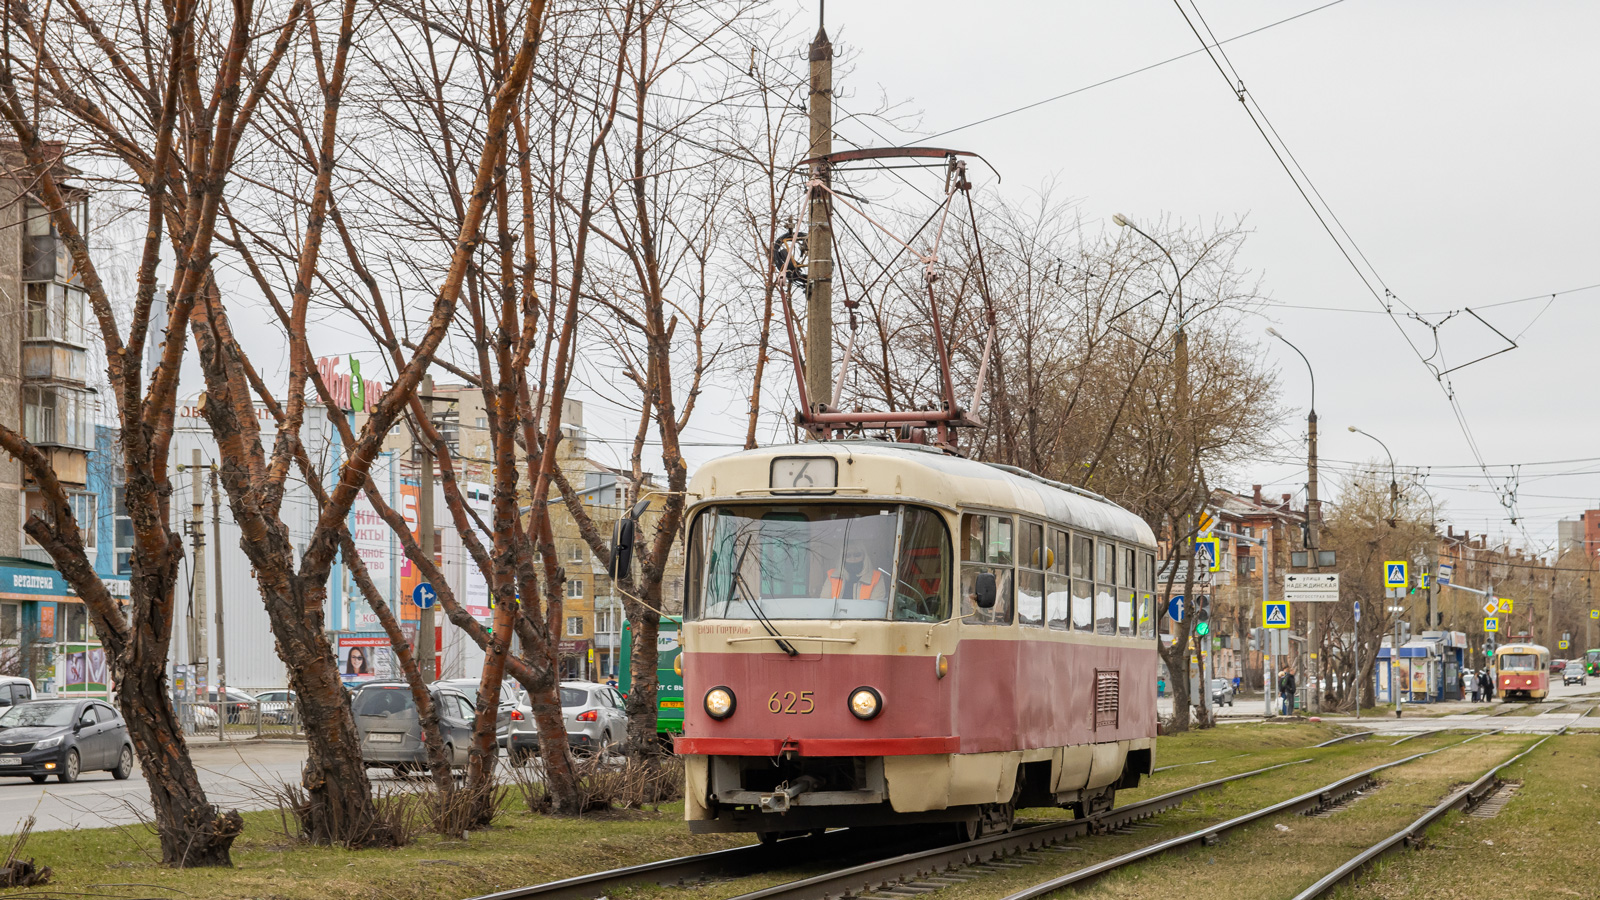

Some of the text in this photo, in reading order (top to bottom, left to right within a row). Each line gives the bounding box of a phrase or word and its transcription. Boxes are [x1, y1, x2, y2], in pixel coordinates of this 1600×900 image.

[792, 462, 814, 493] 6
[13, 575, 54, 590] ветаптека
[767, 690, 815, 715] 625
